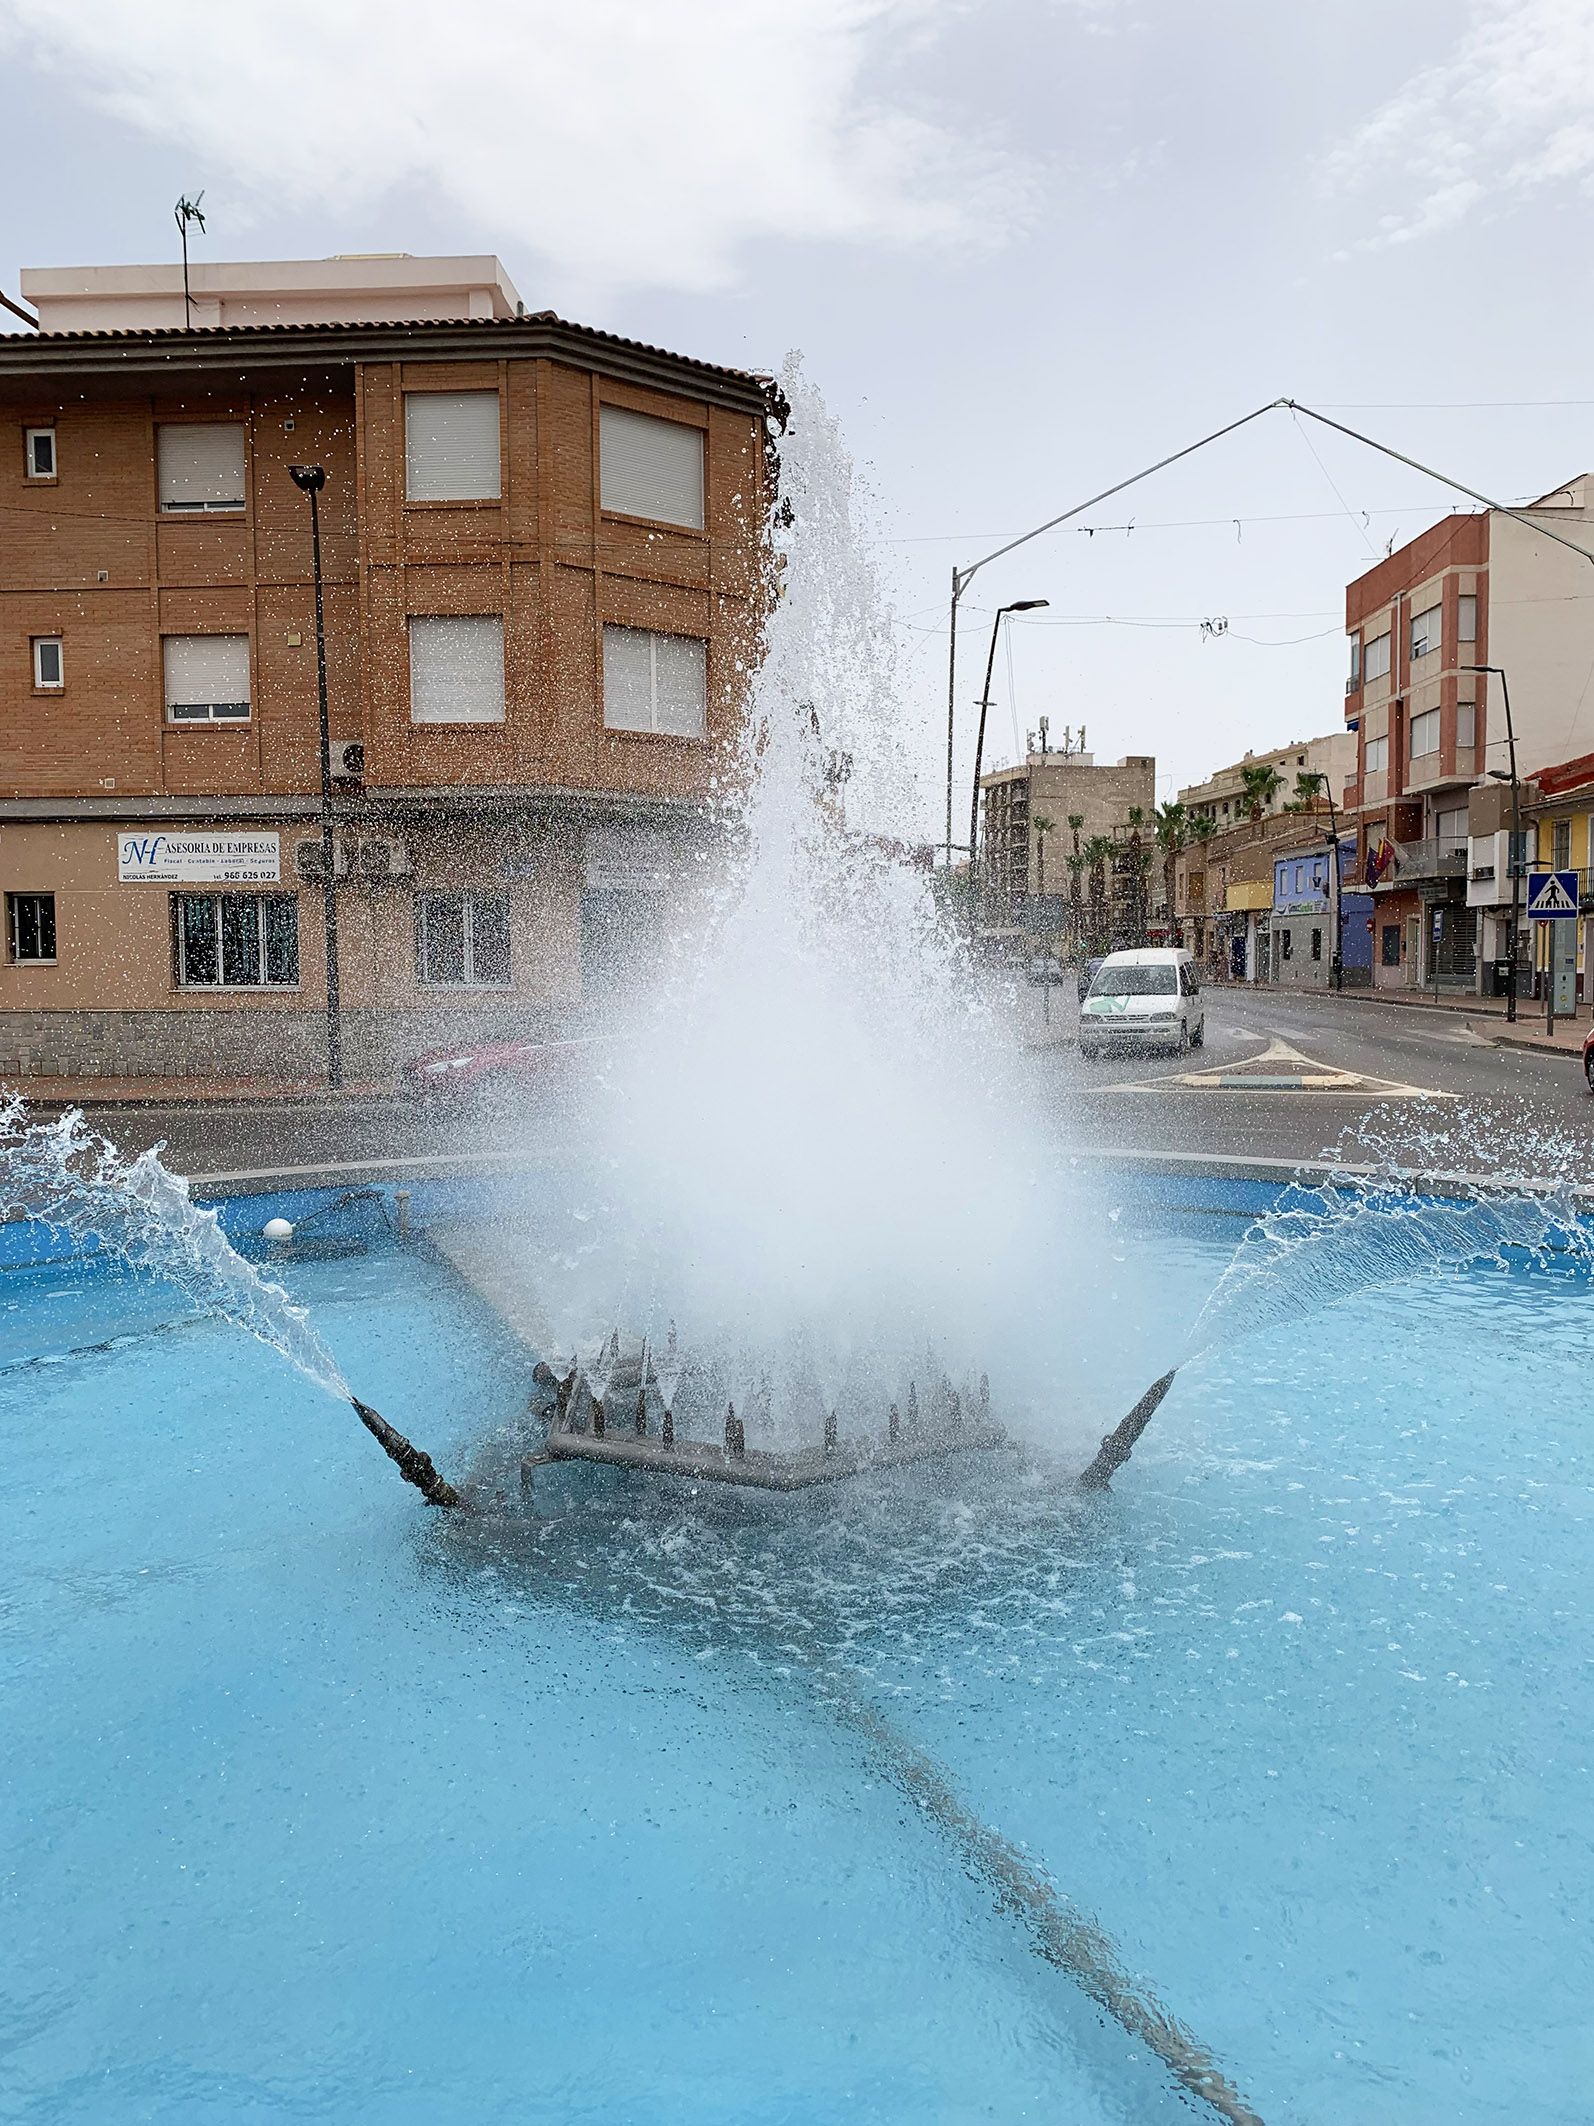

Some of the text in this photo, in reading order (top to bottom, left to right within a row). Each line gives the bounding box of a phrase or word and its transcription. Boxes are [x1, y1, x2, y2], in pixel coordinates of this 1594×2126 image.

[212, 842, 226, 854] DE
[227, 842, 277, 854] EMPRESAS
[260, 871, 277, 880] 027
